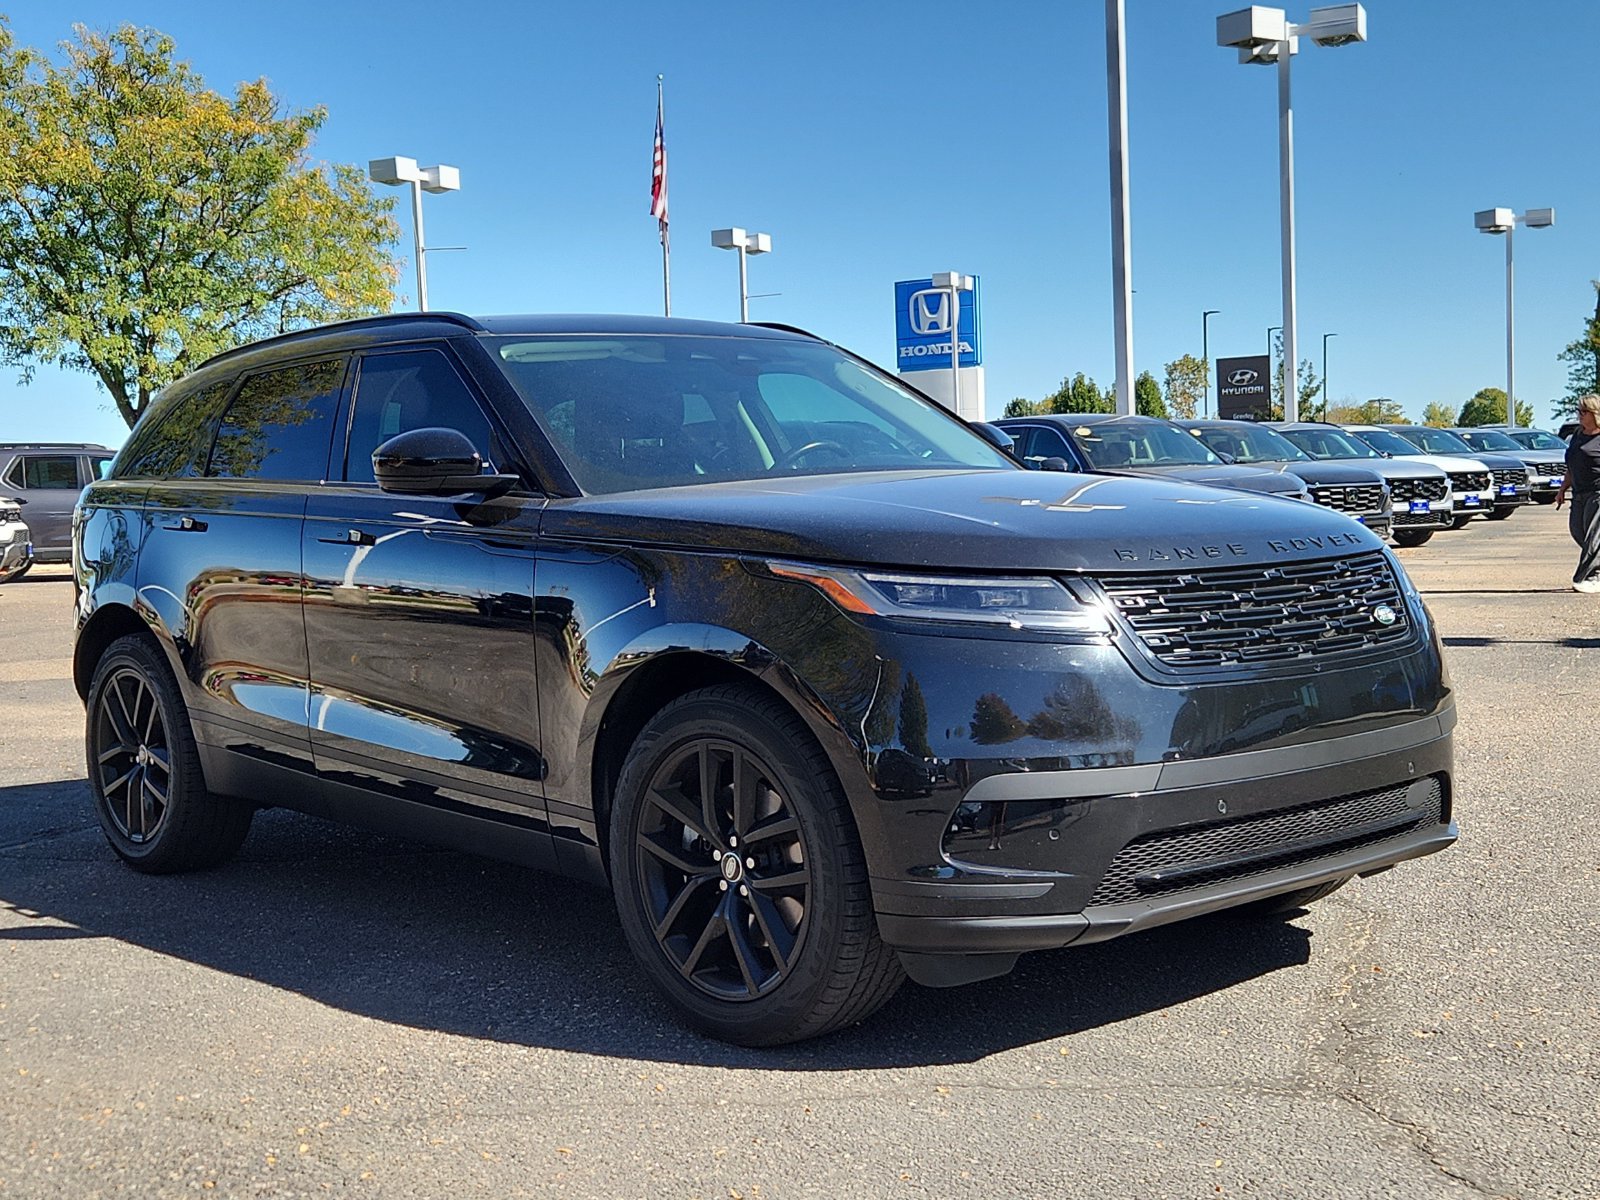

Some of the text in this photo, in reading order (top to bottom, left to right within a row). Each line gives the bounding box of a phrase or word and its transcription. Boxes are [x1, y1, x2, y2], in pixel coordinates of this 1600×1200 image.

[899, 341, 974, 358] HONDA
[1221, 385, 1264, 396] HYUNDAI
[1113, 532, 1362, 563] RANGE ROVER
